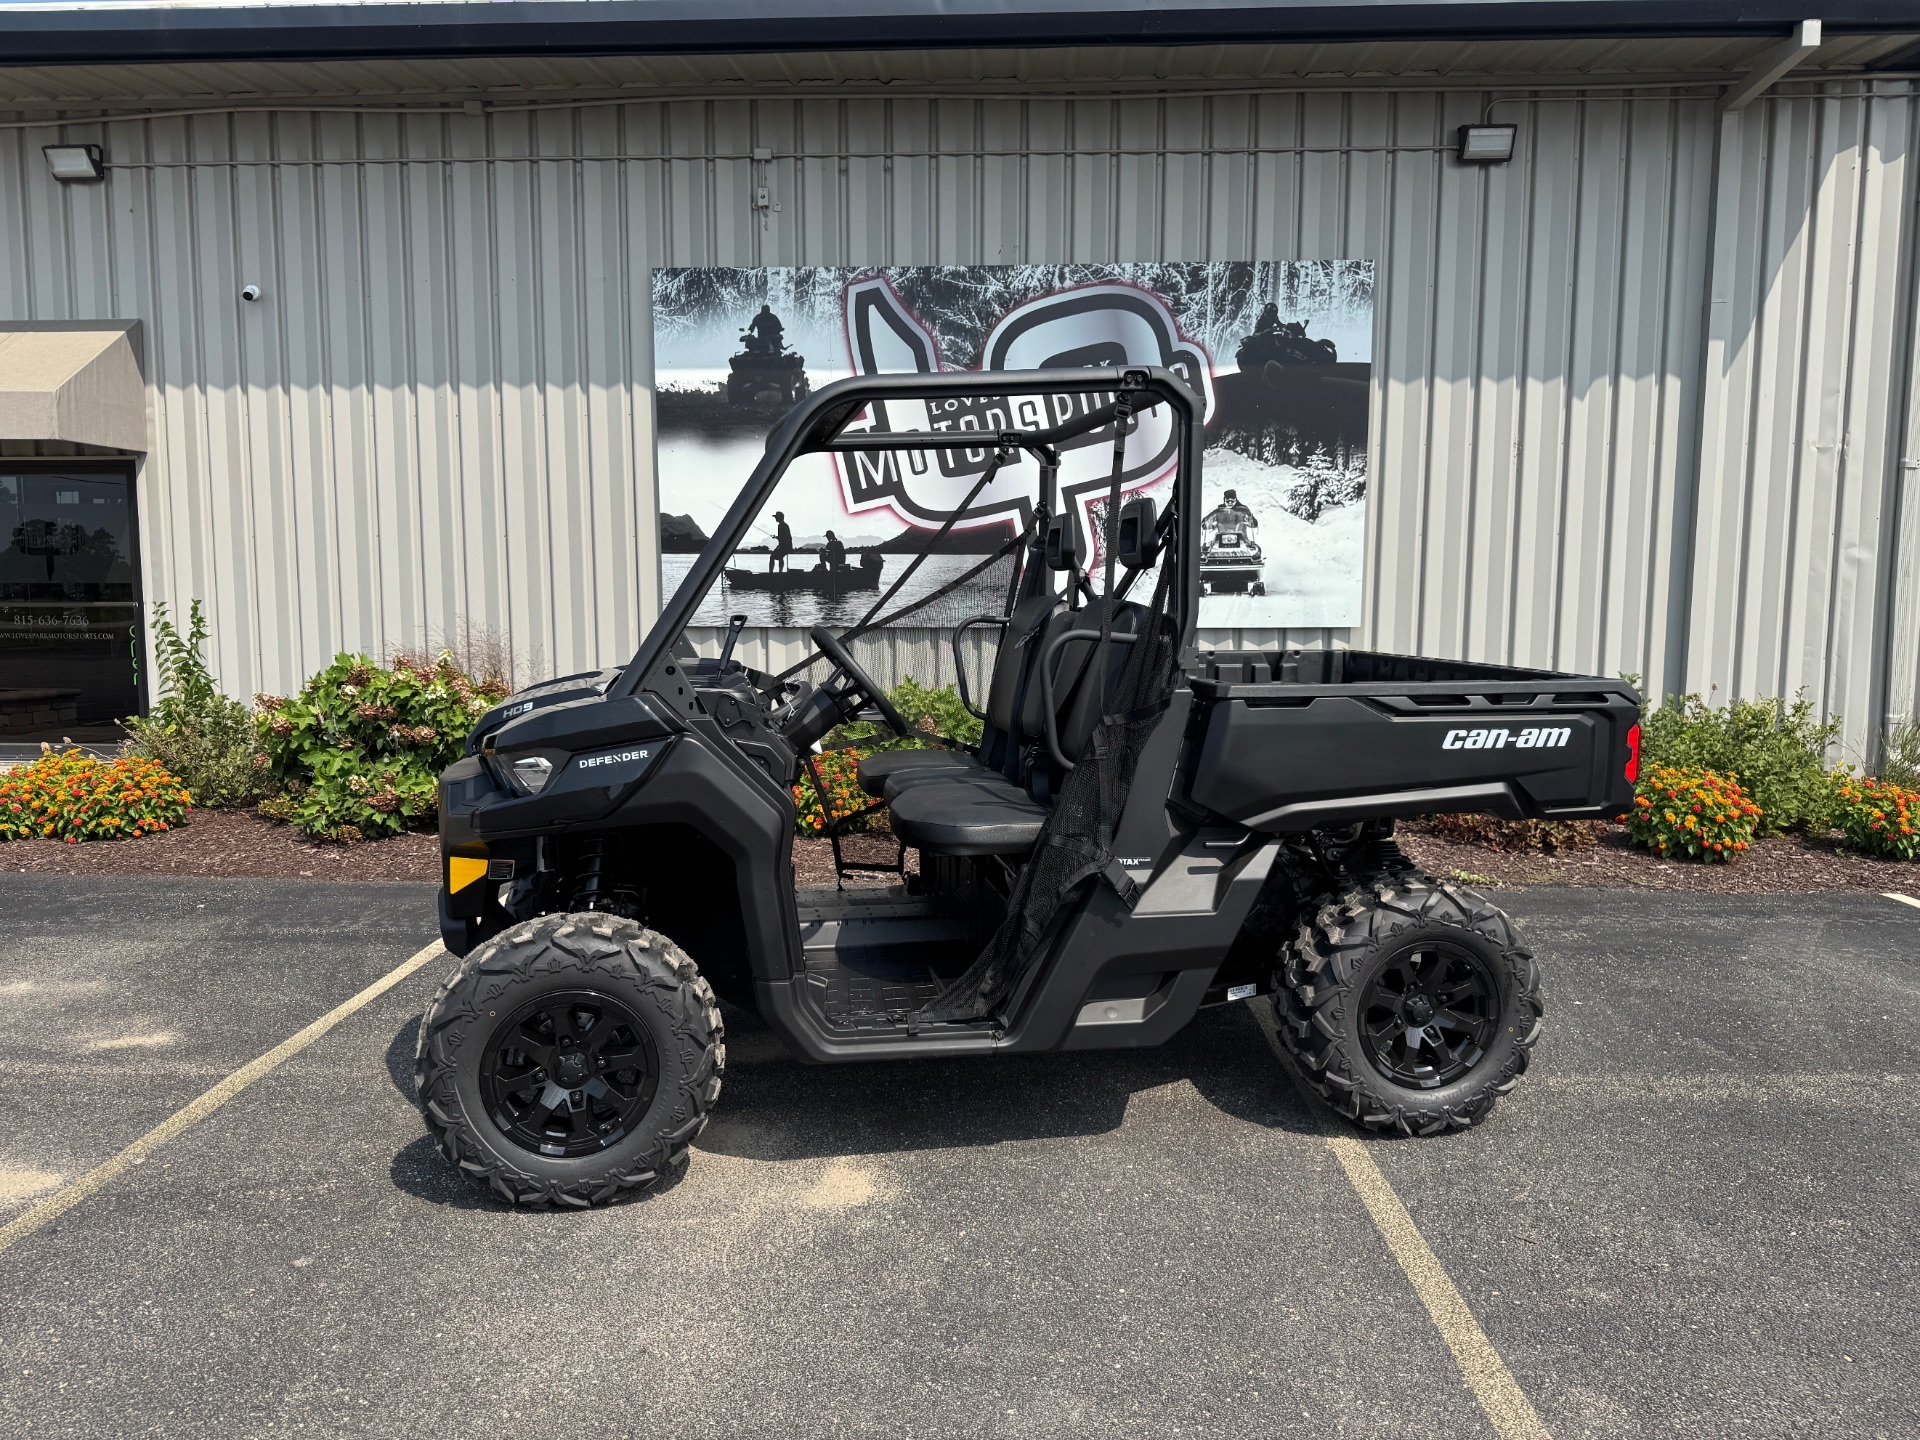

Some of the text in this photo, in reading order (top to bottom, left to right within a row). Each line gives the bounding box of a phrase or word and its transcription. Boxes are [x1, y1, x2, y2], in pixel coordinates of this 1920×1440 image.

[930, 396, 1001, 415] LOV
[13, 615, 89, 626] 815-636-7636
[502, 702, 533, 719] HD9
[1442, 727, 1572, 750] can-am
[579, 749, 649, 769] DEFENDER
